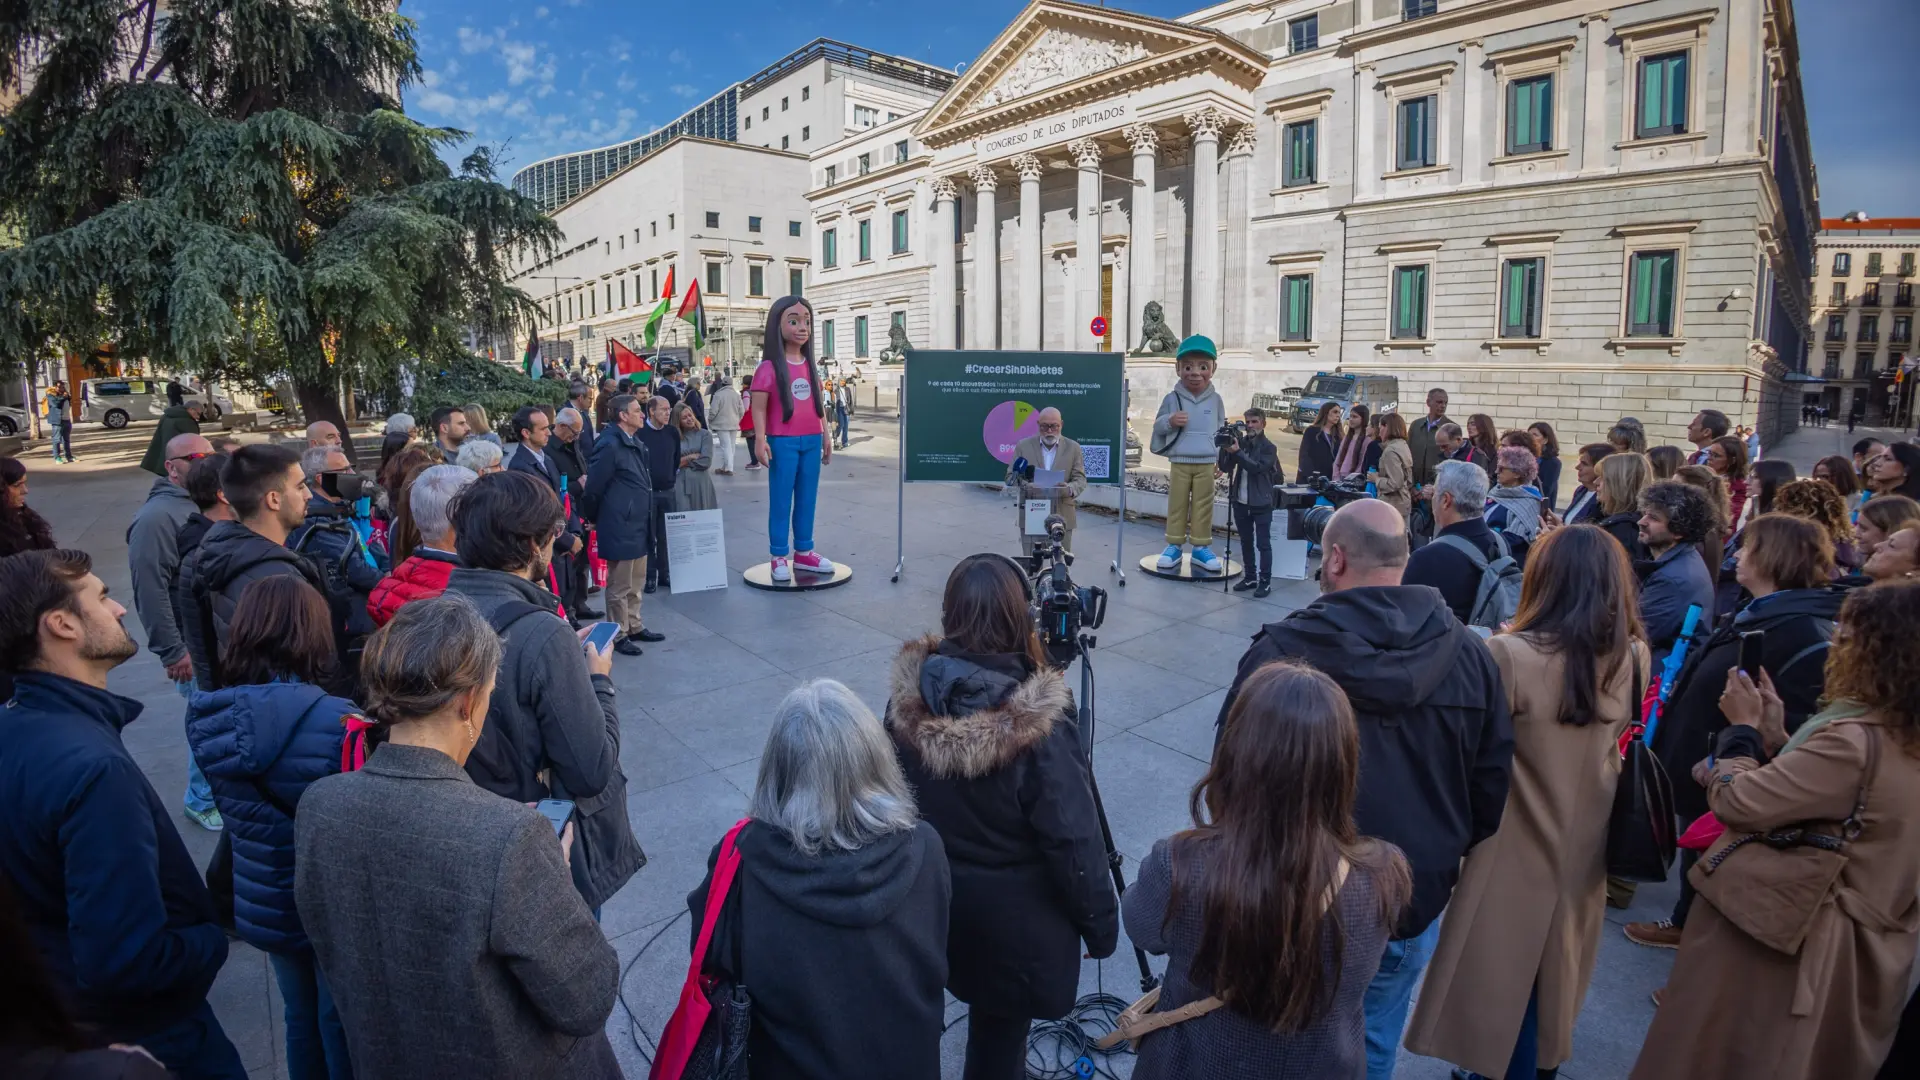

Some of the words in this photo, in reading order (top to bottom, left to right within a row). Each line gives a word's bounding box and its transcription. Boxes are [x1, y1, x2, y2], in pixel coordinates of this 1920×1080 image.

[986, 133, 1028, 152] CONGRESO
[1033, 128, 1044, 140] DE
[1049, 122, 1066, 135] LOS
[1072, 105, 1125, 129] DIPUTADOS
[965, 364, 1063, 375] #CrecerSinDiabetes
